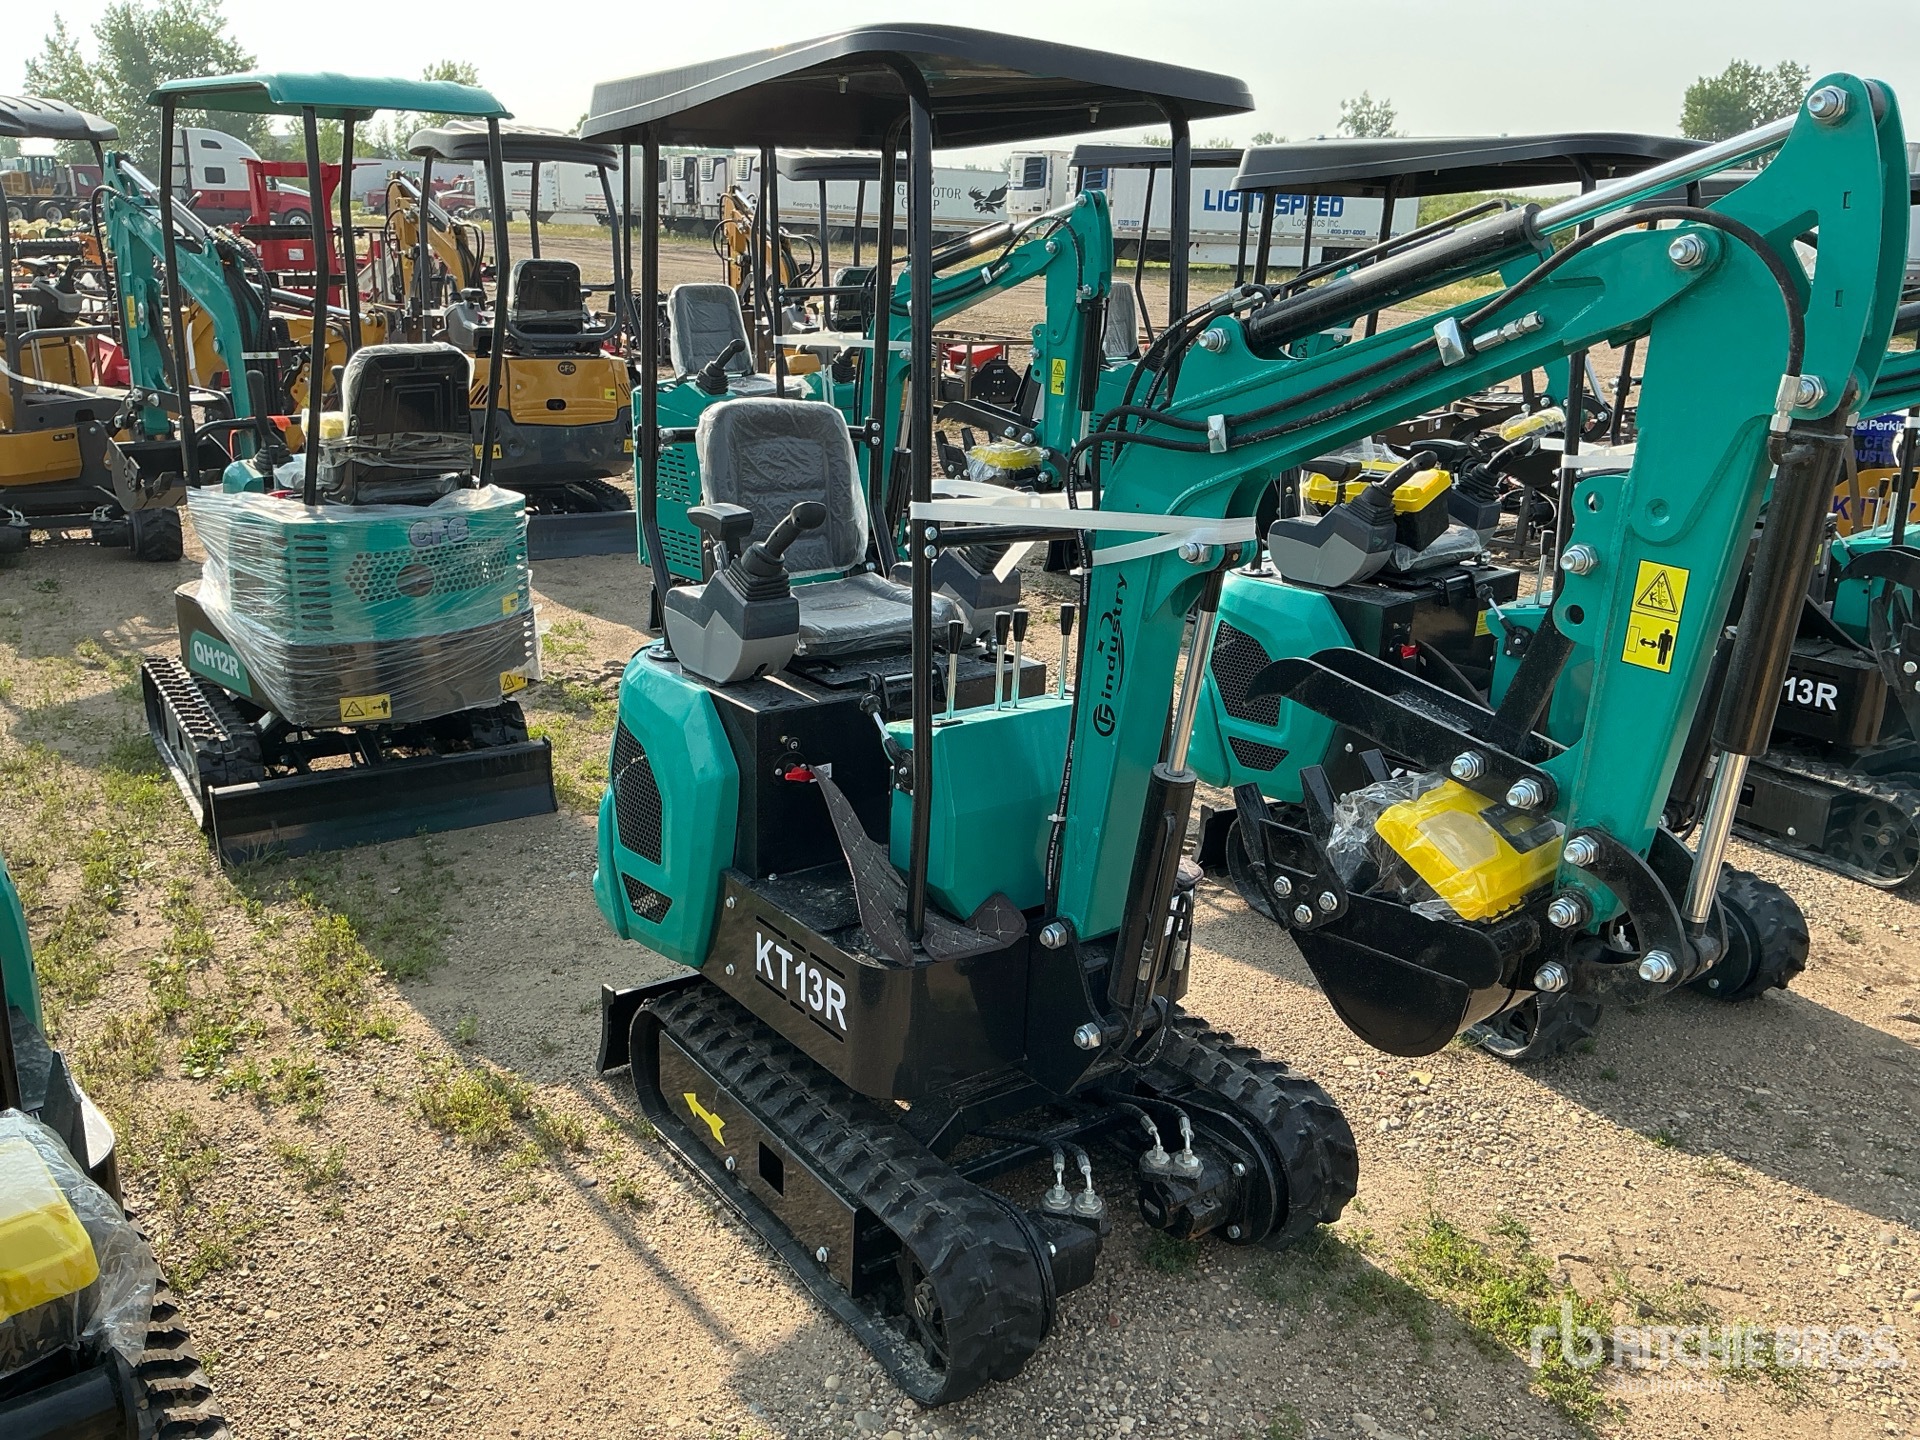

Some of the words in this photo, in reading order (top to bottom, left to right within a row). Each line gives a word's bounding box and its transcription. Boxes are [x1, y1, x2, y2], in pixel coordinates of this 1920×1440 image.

[932, 186, 961, 199] OTOR
[559, 364, 575, 372] CFG
[1868, 420, 1906, 431] Perkin
[408, 516, 470, 547] CFG
[193, 640, 240, 680] QH12R
[756, 931, 847, 1031] KT13R
